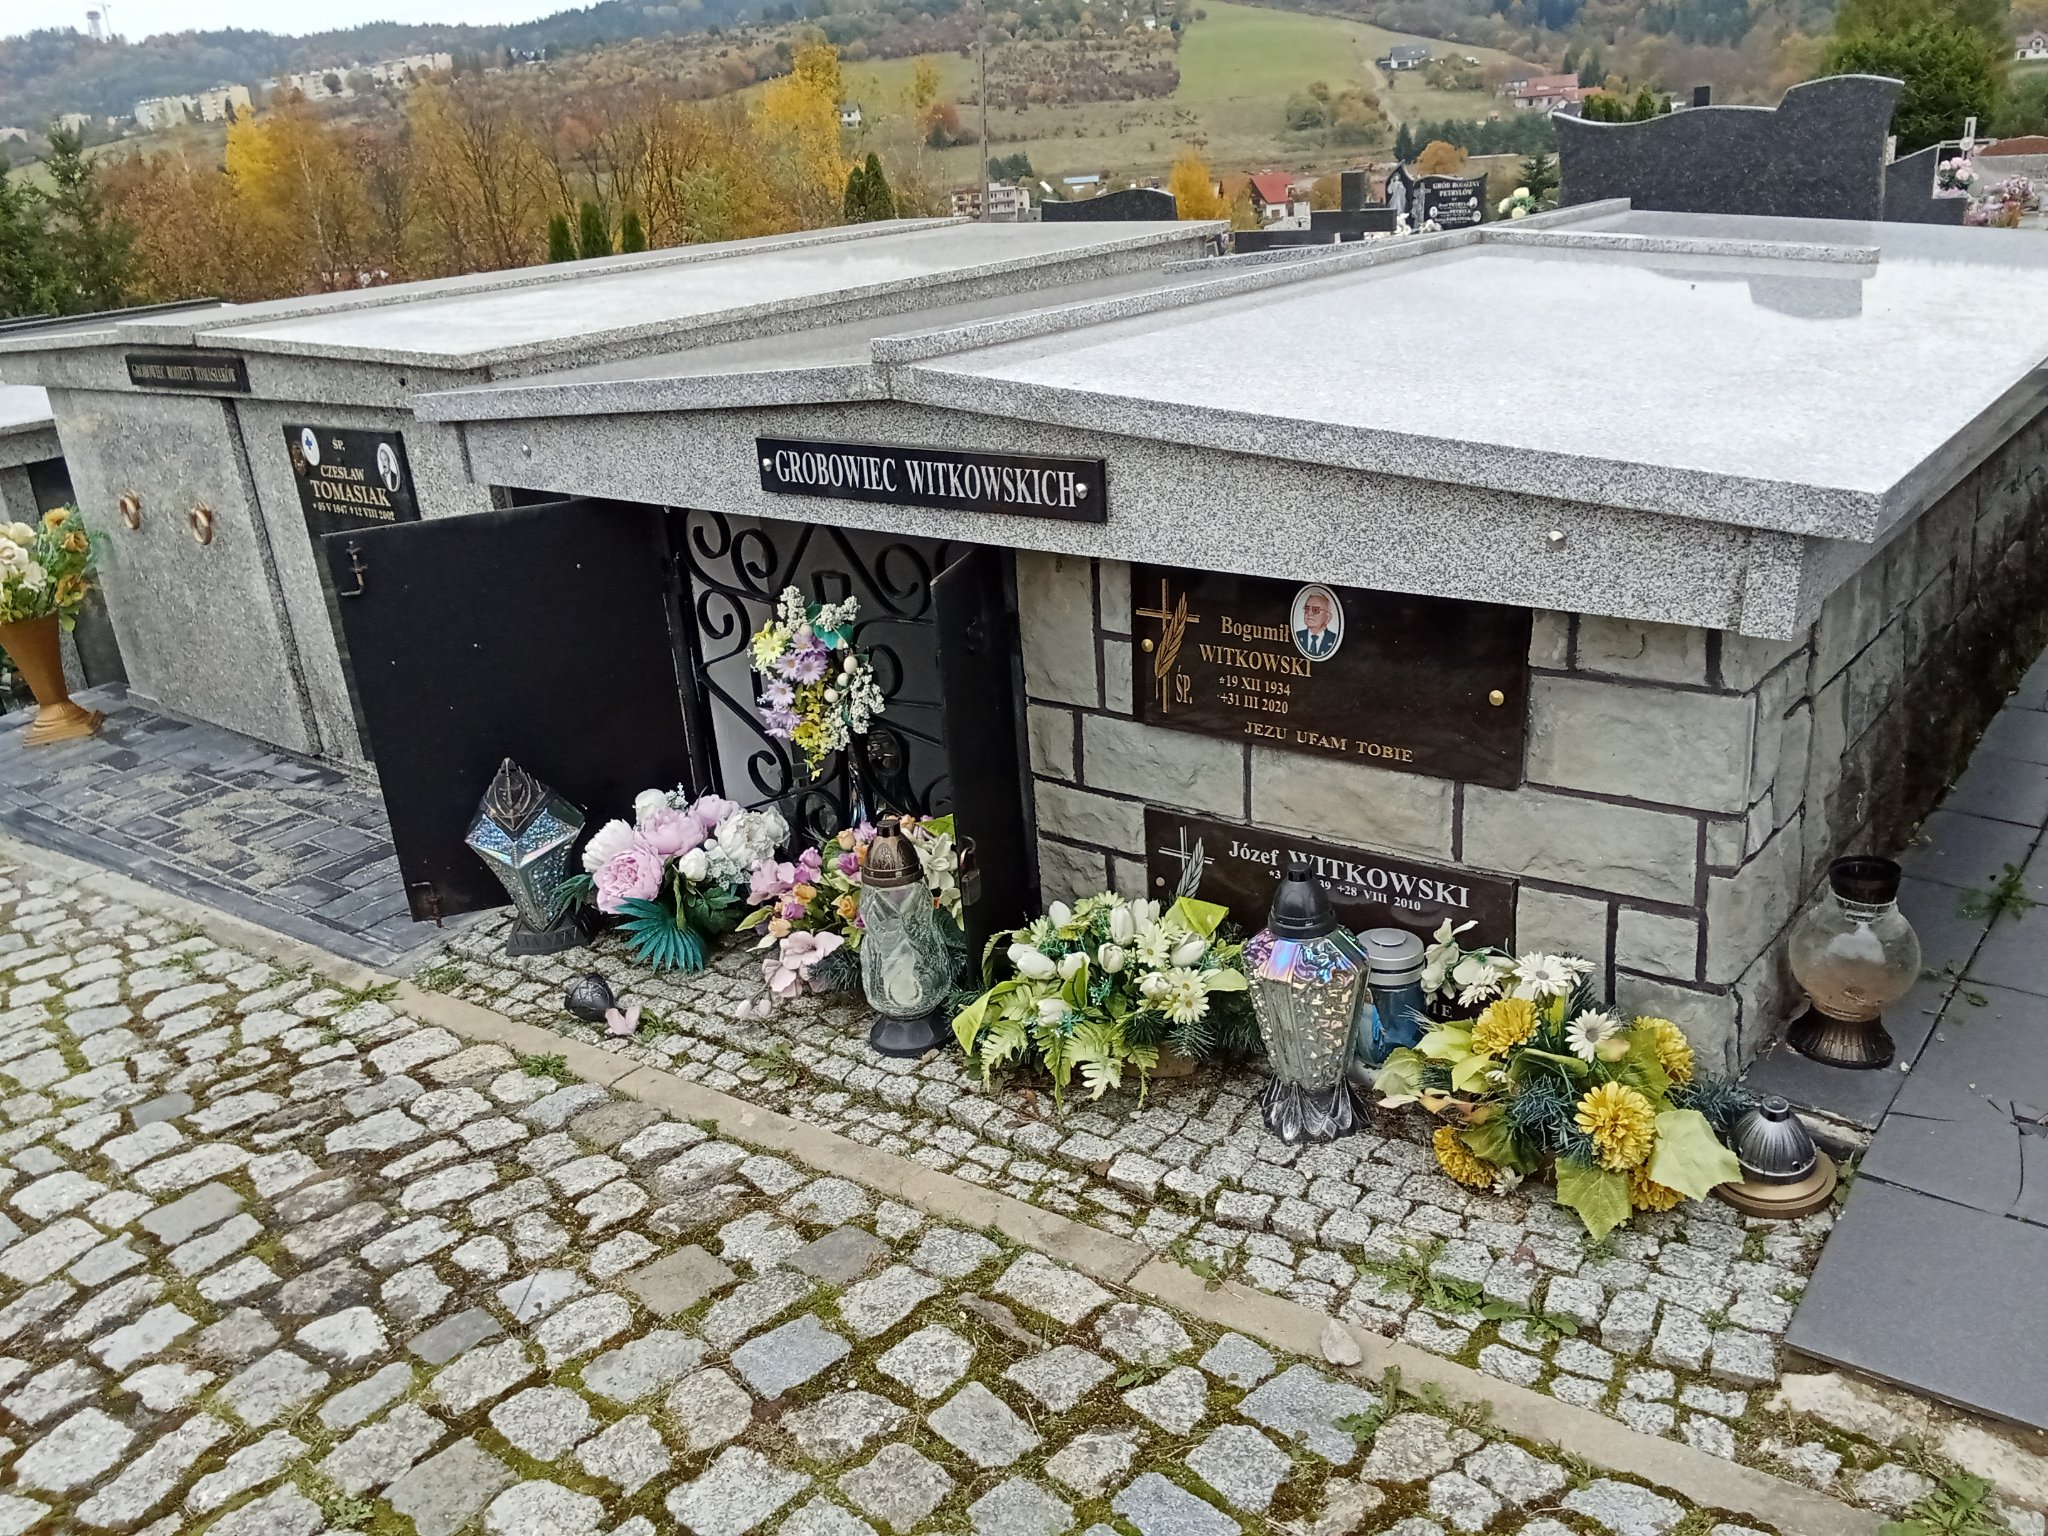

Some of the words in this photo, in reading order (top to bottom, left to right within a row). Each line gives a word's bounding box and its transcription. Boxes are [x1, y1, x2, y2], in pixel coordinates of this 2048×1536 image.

[775, 449, 898, 492] GROBOWIEC
[904, 460, 1078, 508] WITKOWSKICH
[310, 480, 392, 507] TOMASIAK
[1220, 616, 1291, 643] Bogumił
[1199, 643, 1313, 678] WITKOWSKI
[1241, 676, 1261, 692] XII
[1264, 680, 1291, 696] 1934
[1244, 695, 1259, 709] III
[1262, 698, 1289, 714] 2020
[1244, 721, 1287, 740] JEZU
[1296, 730, 1347, 751] UFAM
[1355, 741, 1413, 763] TOBIE
[1228, 840, 1279, 867] Józef
[1288, 850, 1471, 909] WITKOWSKI
[1364, 889, 1388, 904] VIII
[1394, 896, 1421, 911] 2010
